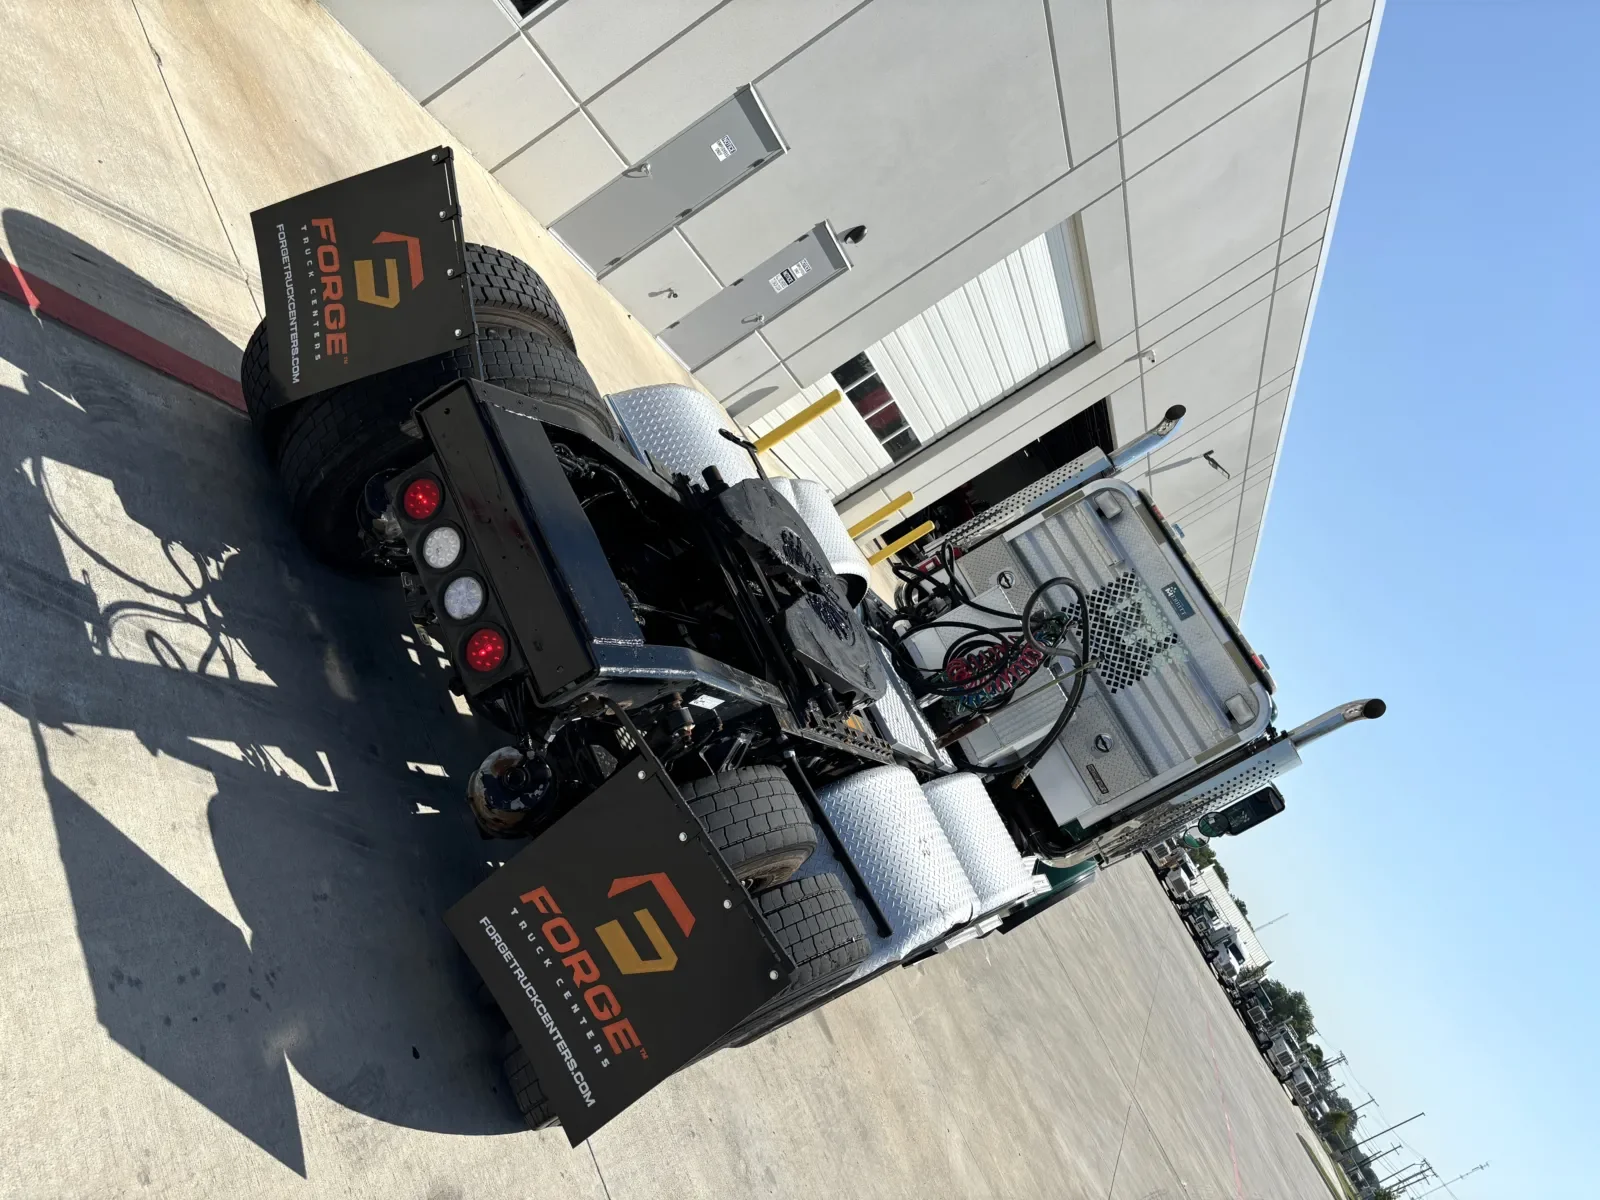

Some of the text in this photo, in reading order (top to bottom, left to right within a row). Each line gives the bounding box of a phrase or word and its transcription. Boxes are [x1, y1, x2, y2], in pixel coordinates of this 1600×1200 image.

[276, 223, 300, 384] FORGETRUCKCENTERS.COM
[301, 225, 320, 360] TRUCK CENTERS
[312, 218, 348, 355] FORGE
[479, 916, 596, 1107] FORGETRUCKCENTERS.COM
[510, 907, 610, 1068] TRUCK CENTERS
[520, 886, 641, 1055] FORGE
